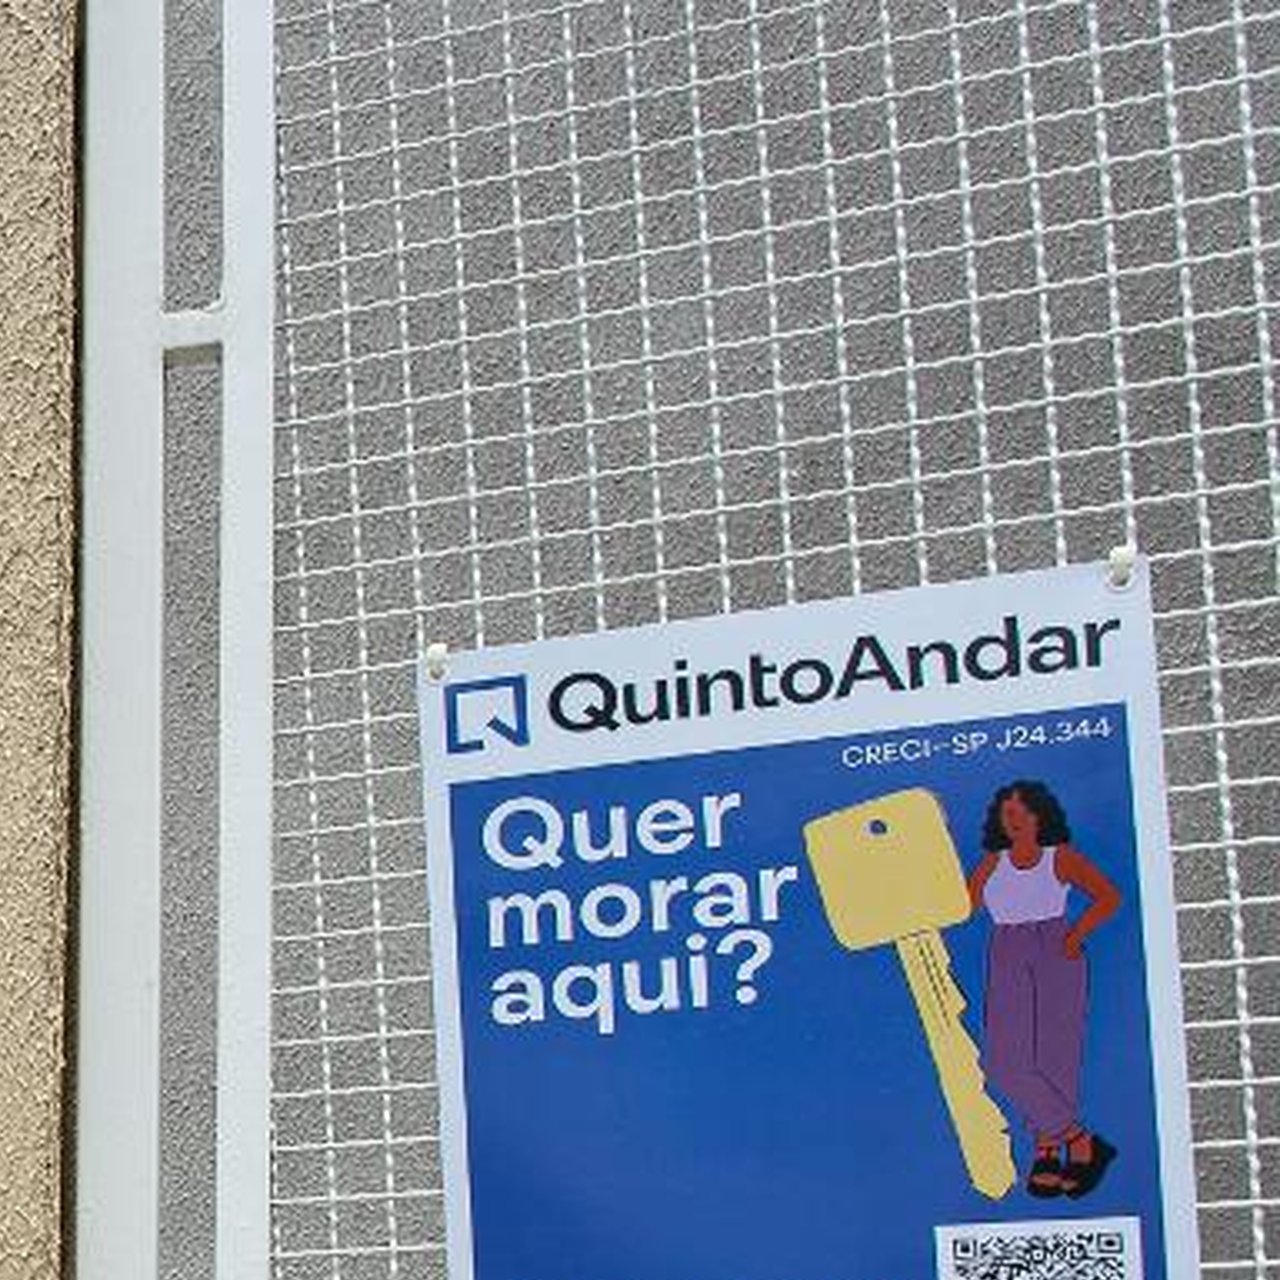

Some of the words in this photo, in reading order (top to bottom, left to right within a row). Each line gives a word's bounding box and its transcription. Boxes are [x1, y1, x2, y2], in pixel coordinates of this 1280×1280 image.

[548, 616, 1121, 732] QuintoAndar
[996, 716, 1114, 752] J24.344
[481, 793, 742, 871] Quer
[486, 860, 800, 948] morar
[489, 928, 774, 1034] aqui?
